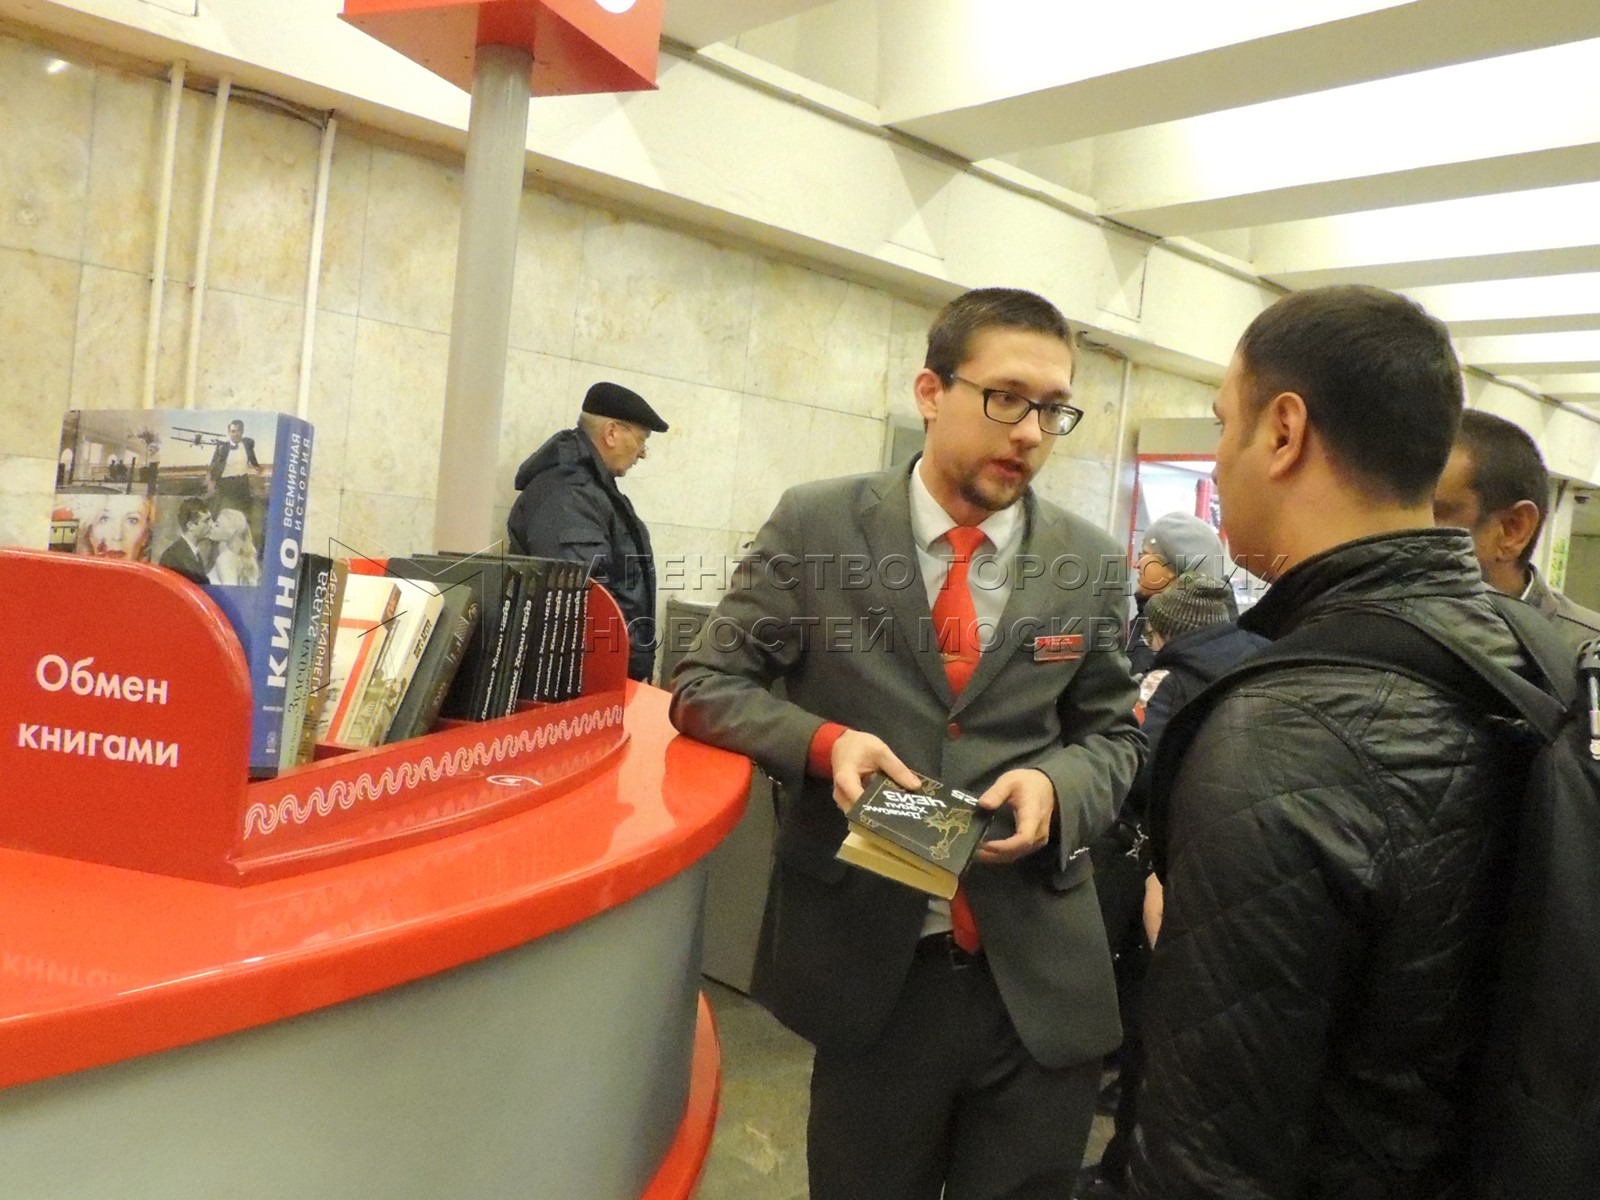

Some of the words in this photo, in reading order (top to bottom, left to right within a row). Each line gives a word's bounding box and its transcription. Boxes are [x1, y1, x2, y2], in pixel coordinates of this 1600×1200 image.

[283, 433, 301, 527] ВСЕМИРНАЯ
[294, 438, 310, 531] ИСТОРИЯ
[267, 538, 299, 688] КИНО
[308, 571, 329, 638] глаза
[499, 600, 511, 632] ЧЕЙЗ
[521, 600, 532, 631] ЧЕЙЗ
[36, 654, 168, 705] Обмен
[18, 722, 179, 768] книгами
[883, 789, 948, 809] ЧЕЙЗ
